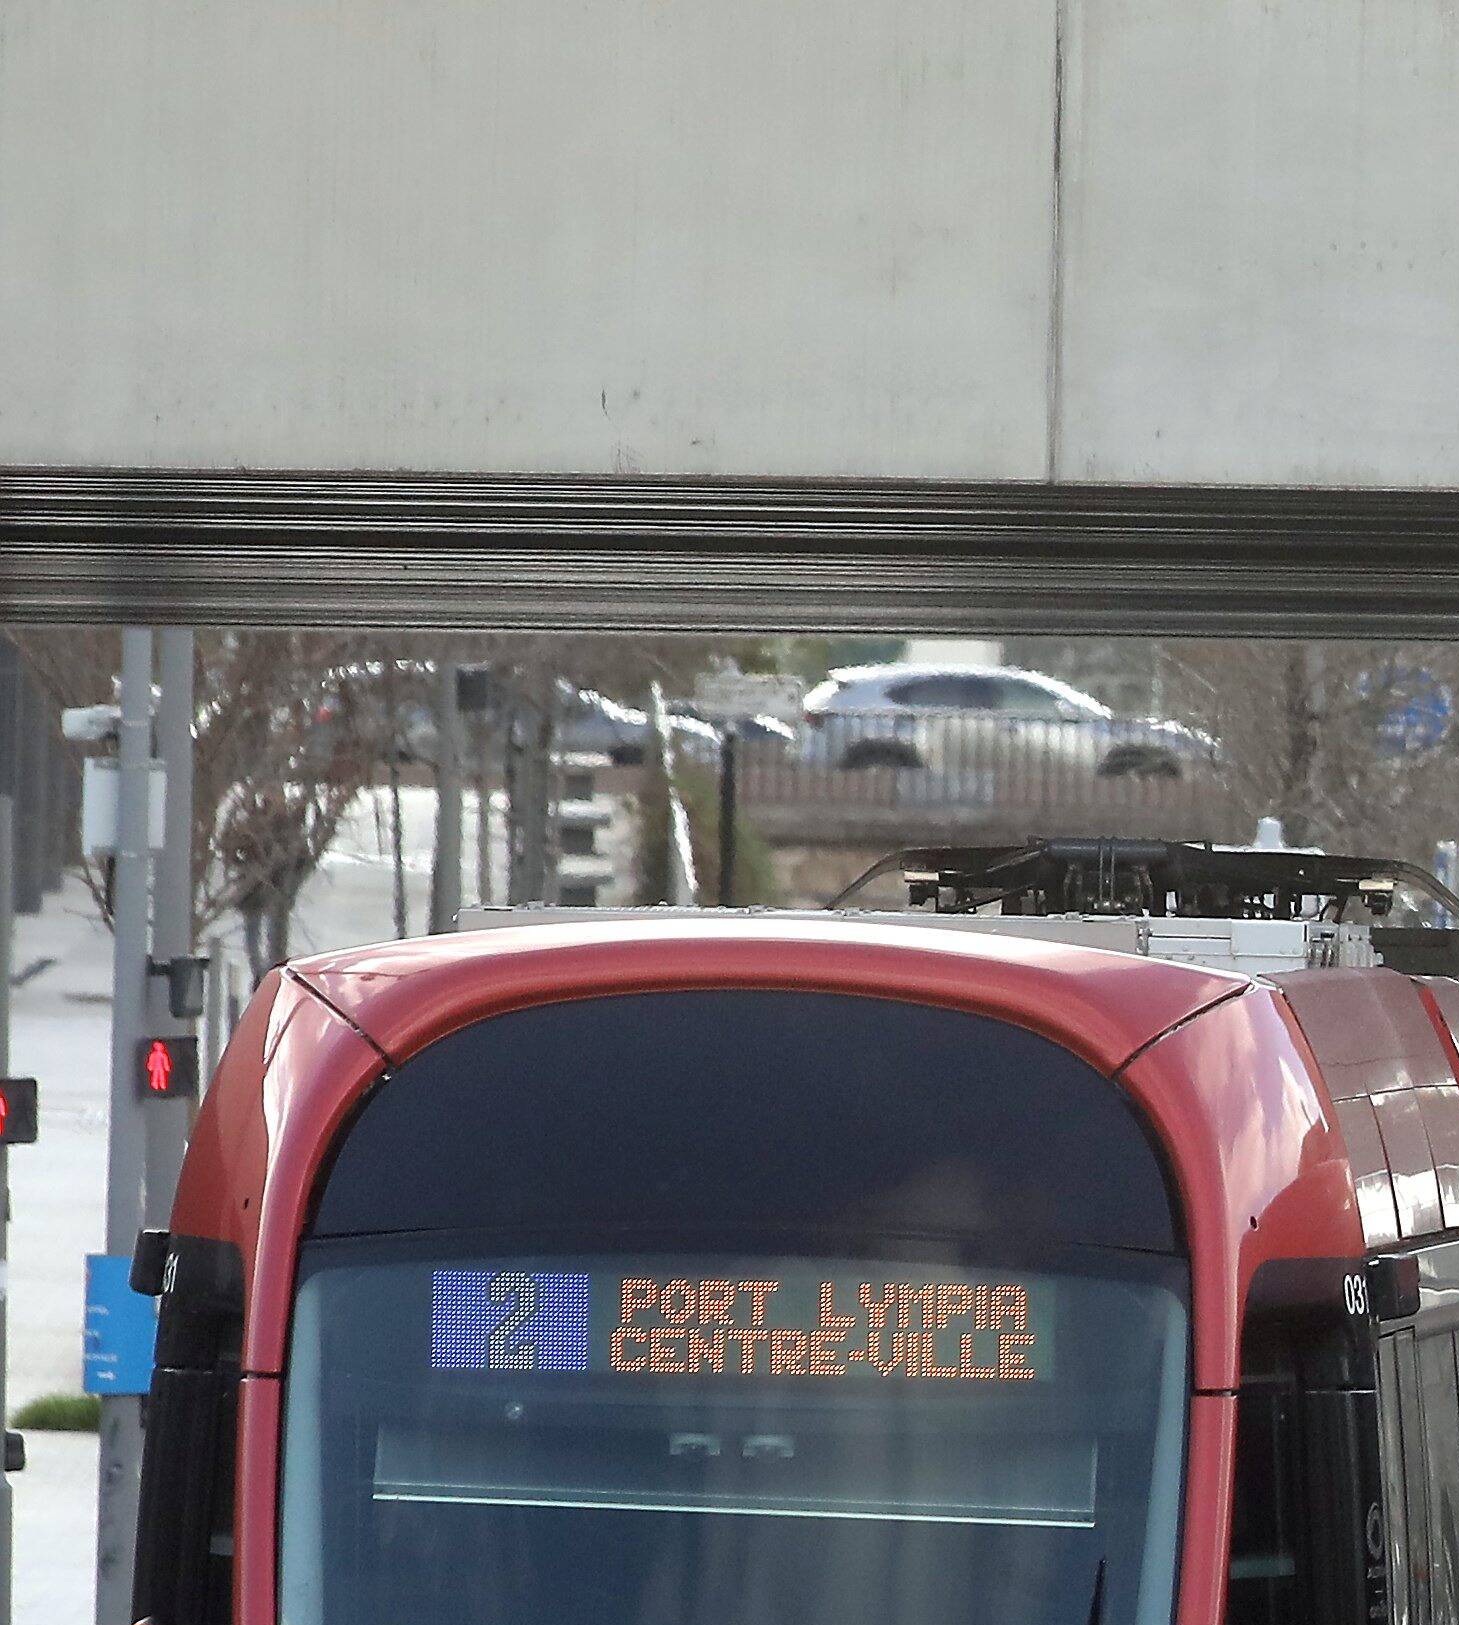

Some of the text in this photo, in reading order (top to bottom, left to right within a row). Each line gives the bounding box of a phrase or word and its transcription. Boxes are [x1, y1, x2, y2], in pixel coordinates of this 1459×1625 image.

[488, 1271, 537, 1370] 2
[620, 1278, 1028, 1332] PORT LYMPIA
[609, 1326, 1036, 1380] CENTRE-VILLE
